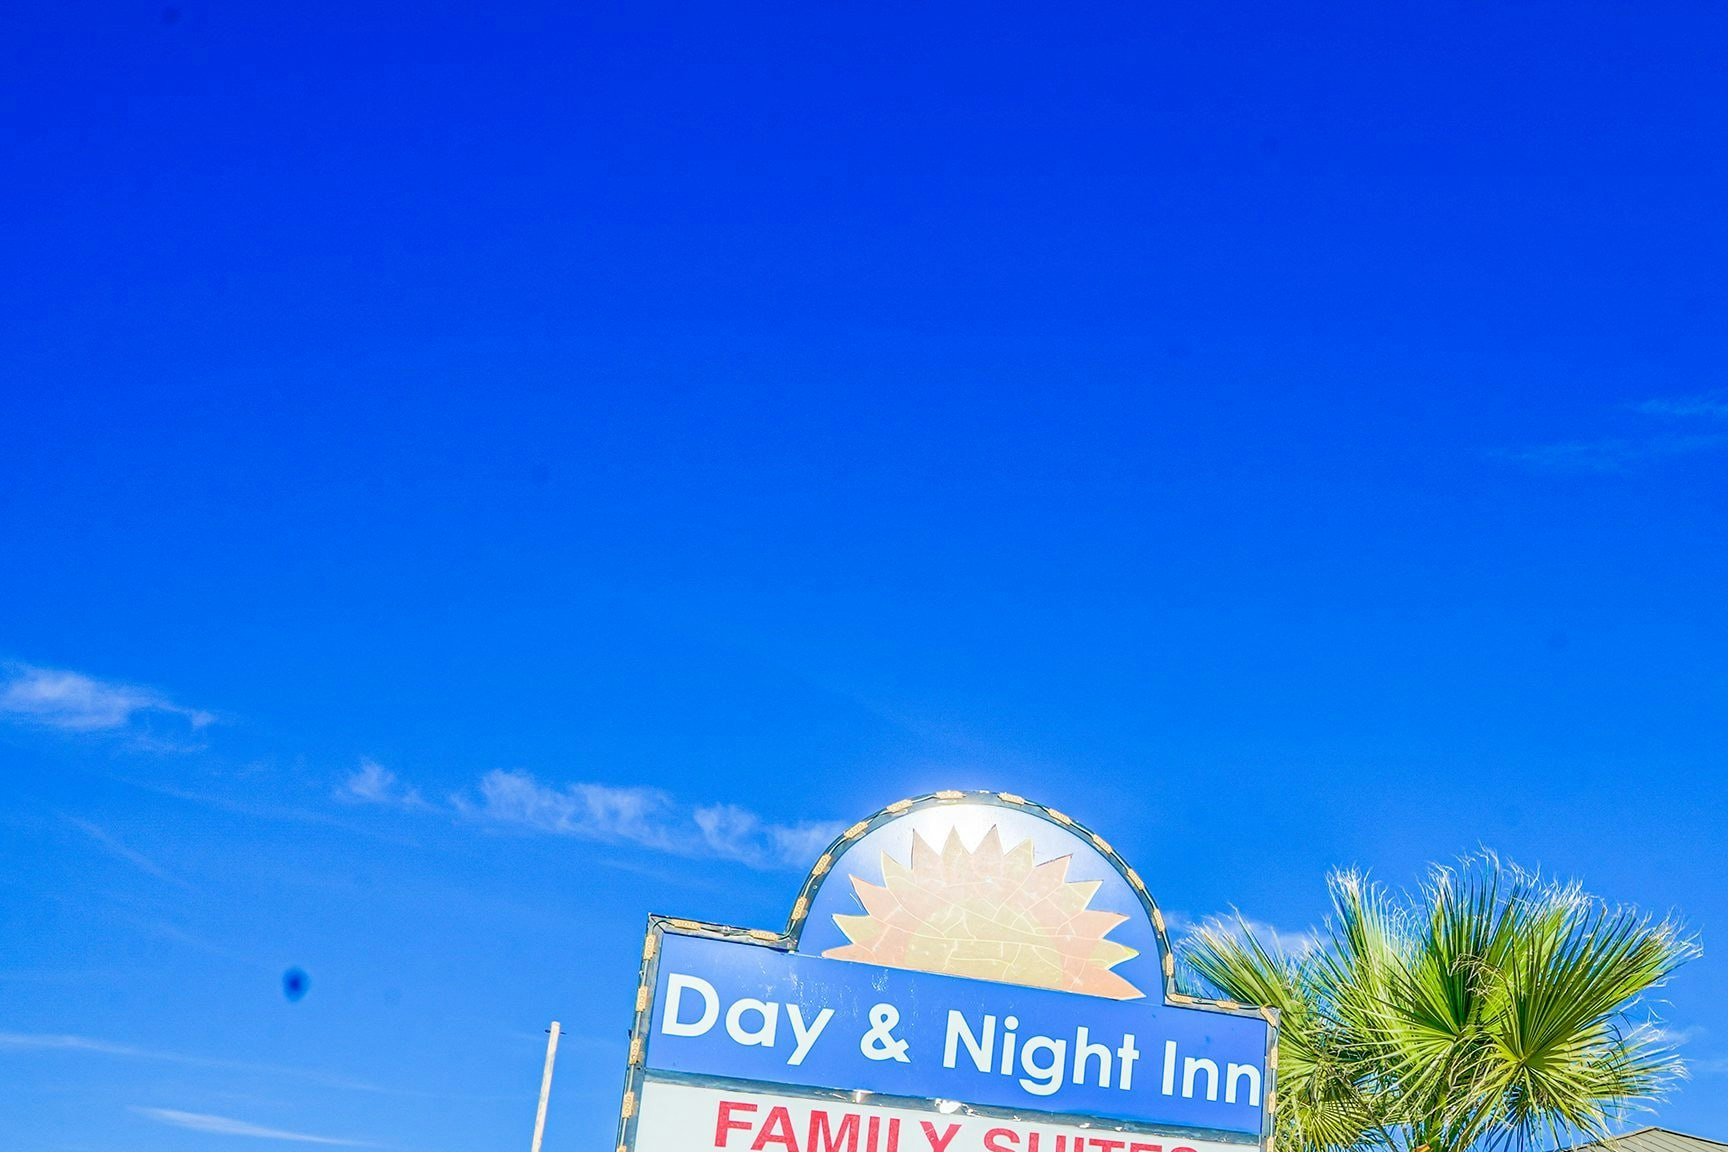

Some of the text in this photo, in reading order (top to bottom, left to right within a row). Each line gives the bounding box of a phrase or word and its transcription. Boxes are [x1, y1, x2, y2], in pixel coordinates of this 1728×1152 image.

[660, 972, 1261, 1108] Day & Night Inn
